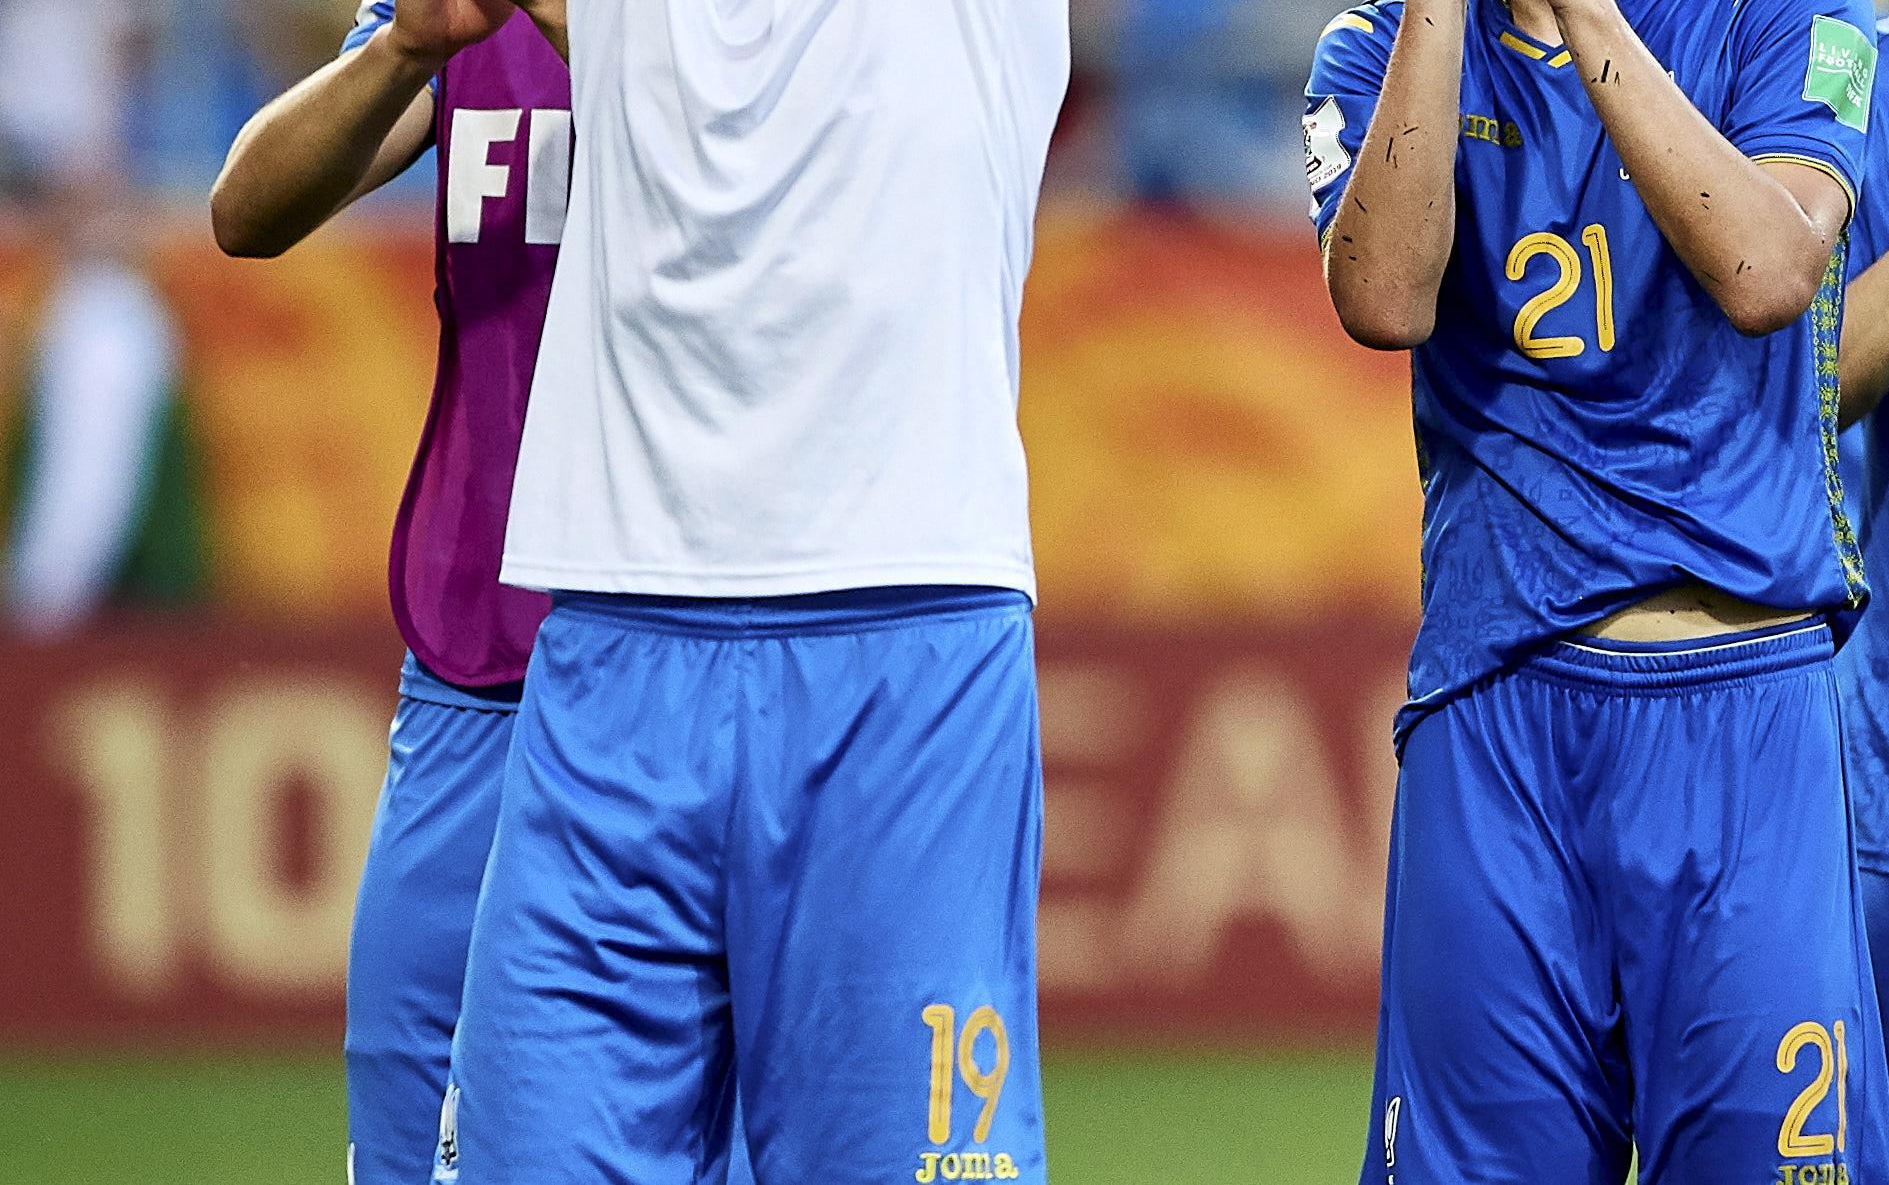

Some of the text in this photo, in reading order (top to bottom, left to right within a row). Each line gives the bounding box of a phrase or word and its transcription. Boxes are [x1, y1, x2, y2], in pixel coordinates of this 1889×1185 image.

[1506, 223, 1615, 359] 21
[60, 676, 394, 990] 10
[921, 1004, 1010, 1145] 19
[1776, 1019, 1847, 1158] 21
